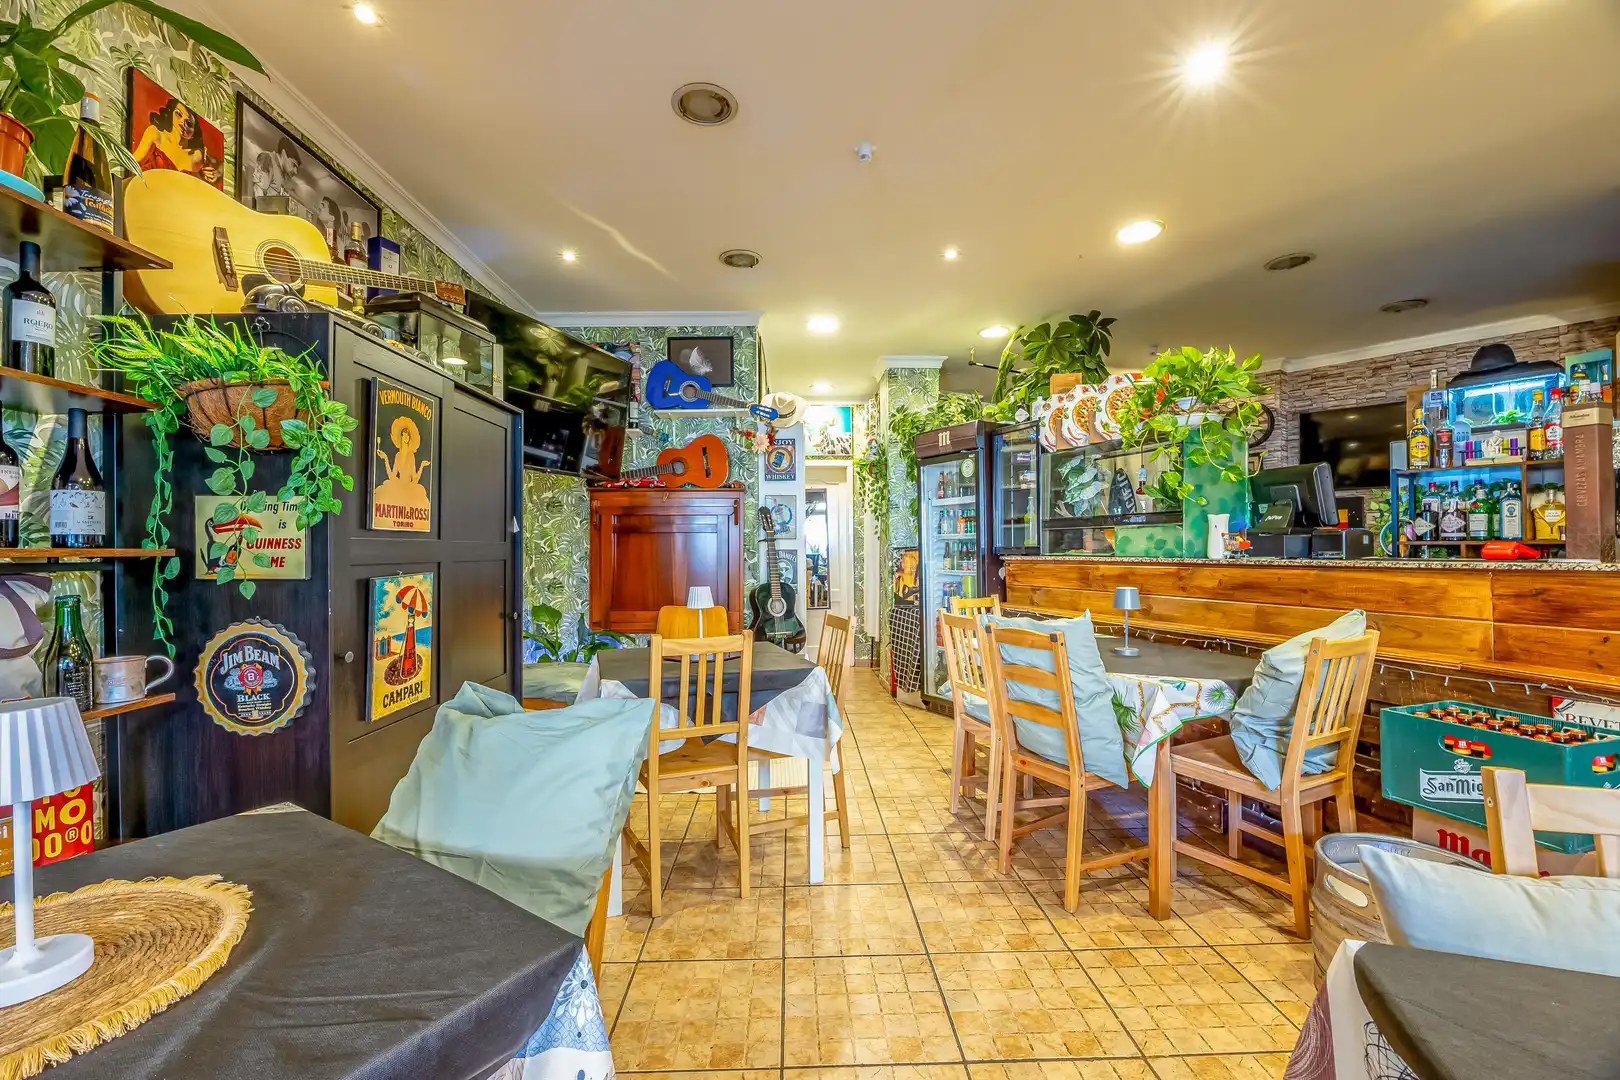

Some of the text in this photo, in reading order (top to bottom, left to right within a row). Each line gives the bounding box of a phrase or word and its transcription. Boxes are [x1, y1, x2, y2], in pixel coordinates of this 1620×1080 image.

[379, 389, 432, 420] VERMOUTH BIANCO
[240, 500, 298, 514] Oing Tim
[278, 519, 287, 529] is
[220, 645, 280, 675] JIM BEAM
[237, 693, 271, 702] BLACK
[383, 681, 423, 708] CAMPARI
[1422, 777, 1484, 797] San Mig
[1436, 828, 1491, 866] Ma
